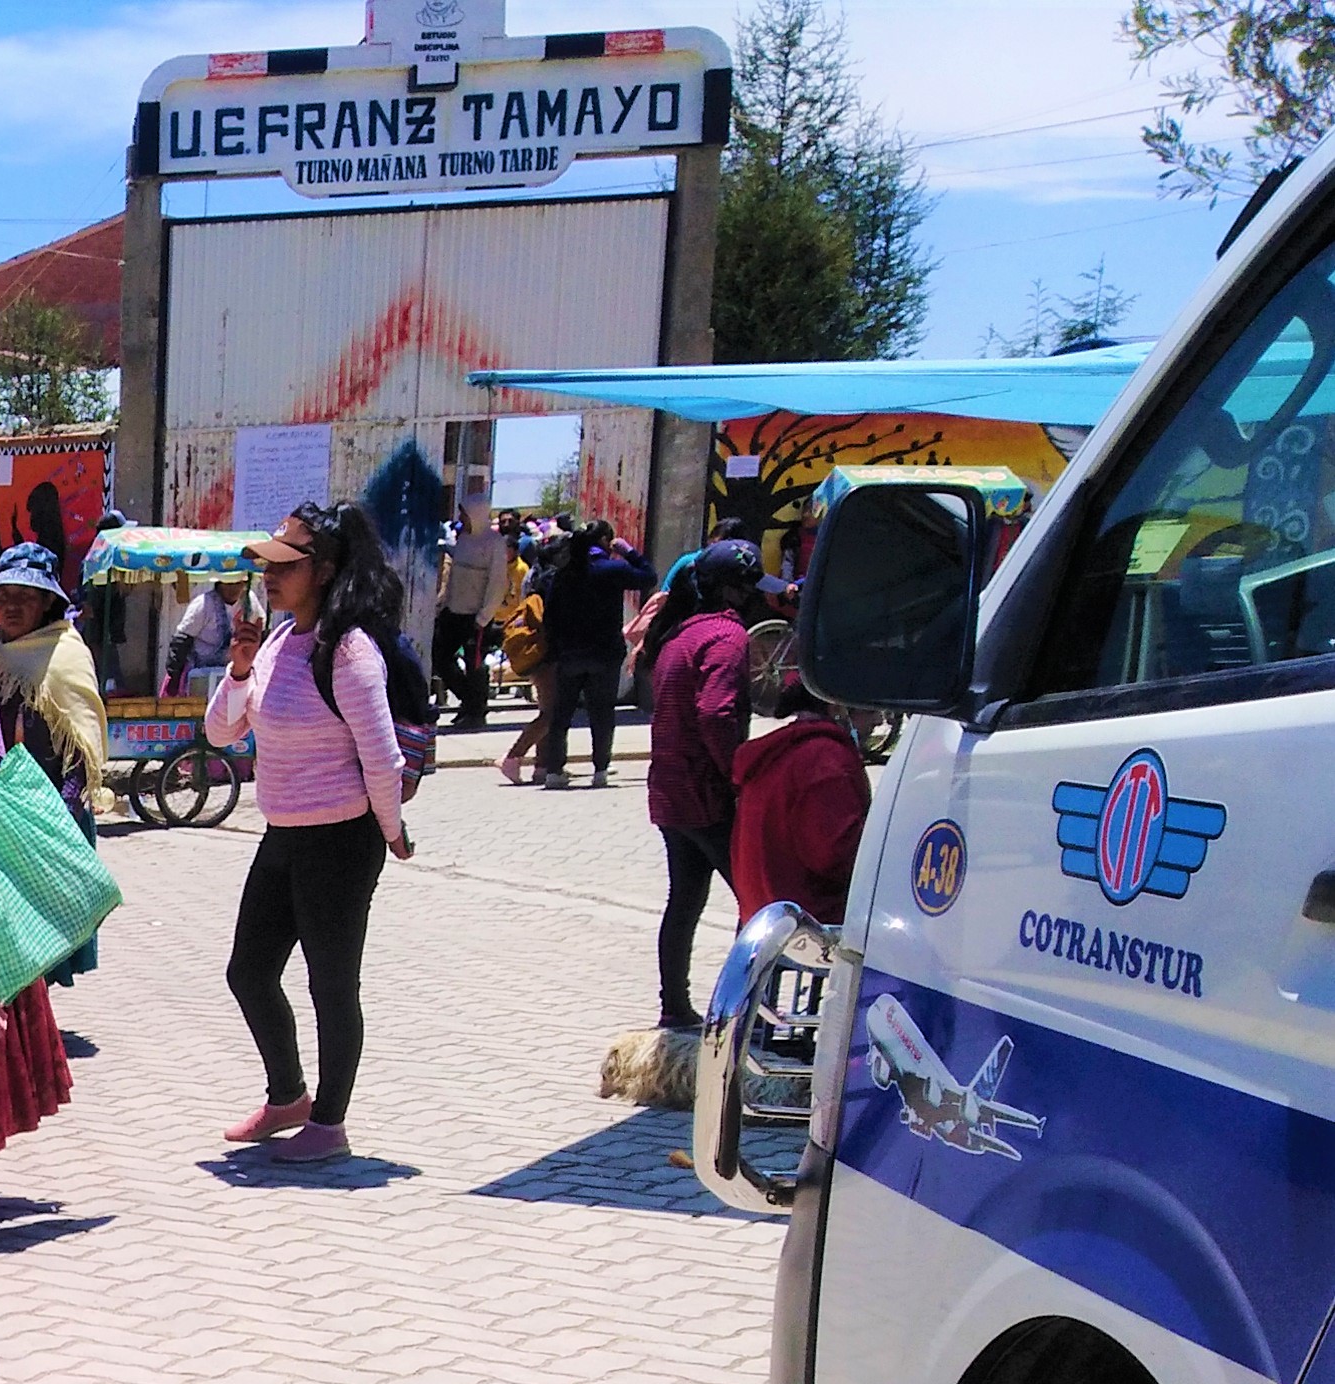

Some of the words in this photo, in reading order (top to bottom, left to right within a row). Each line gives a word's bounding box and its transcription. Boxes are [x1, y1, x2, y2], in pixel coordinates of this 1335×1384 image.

[414, 43, 460, 51] DISCIPLINA
[462, 83, 680, 141] TAMAYO
[295, 159, 353, 185] TURNO
[356, 154, 427, 181] MAÑANA
[439, 150, 494, 177] TURNO
[499, 146, 559, 173] TARDE
[917, 841, 960, 898] A-38
[1019, 909, 1204, 998] COTRANSTUR
